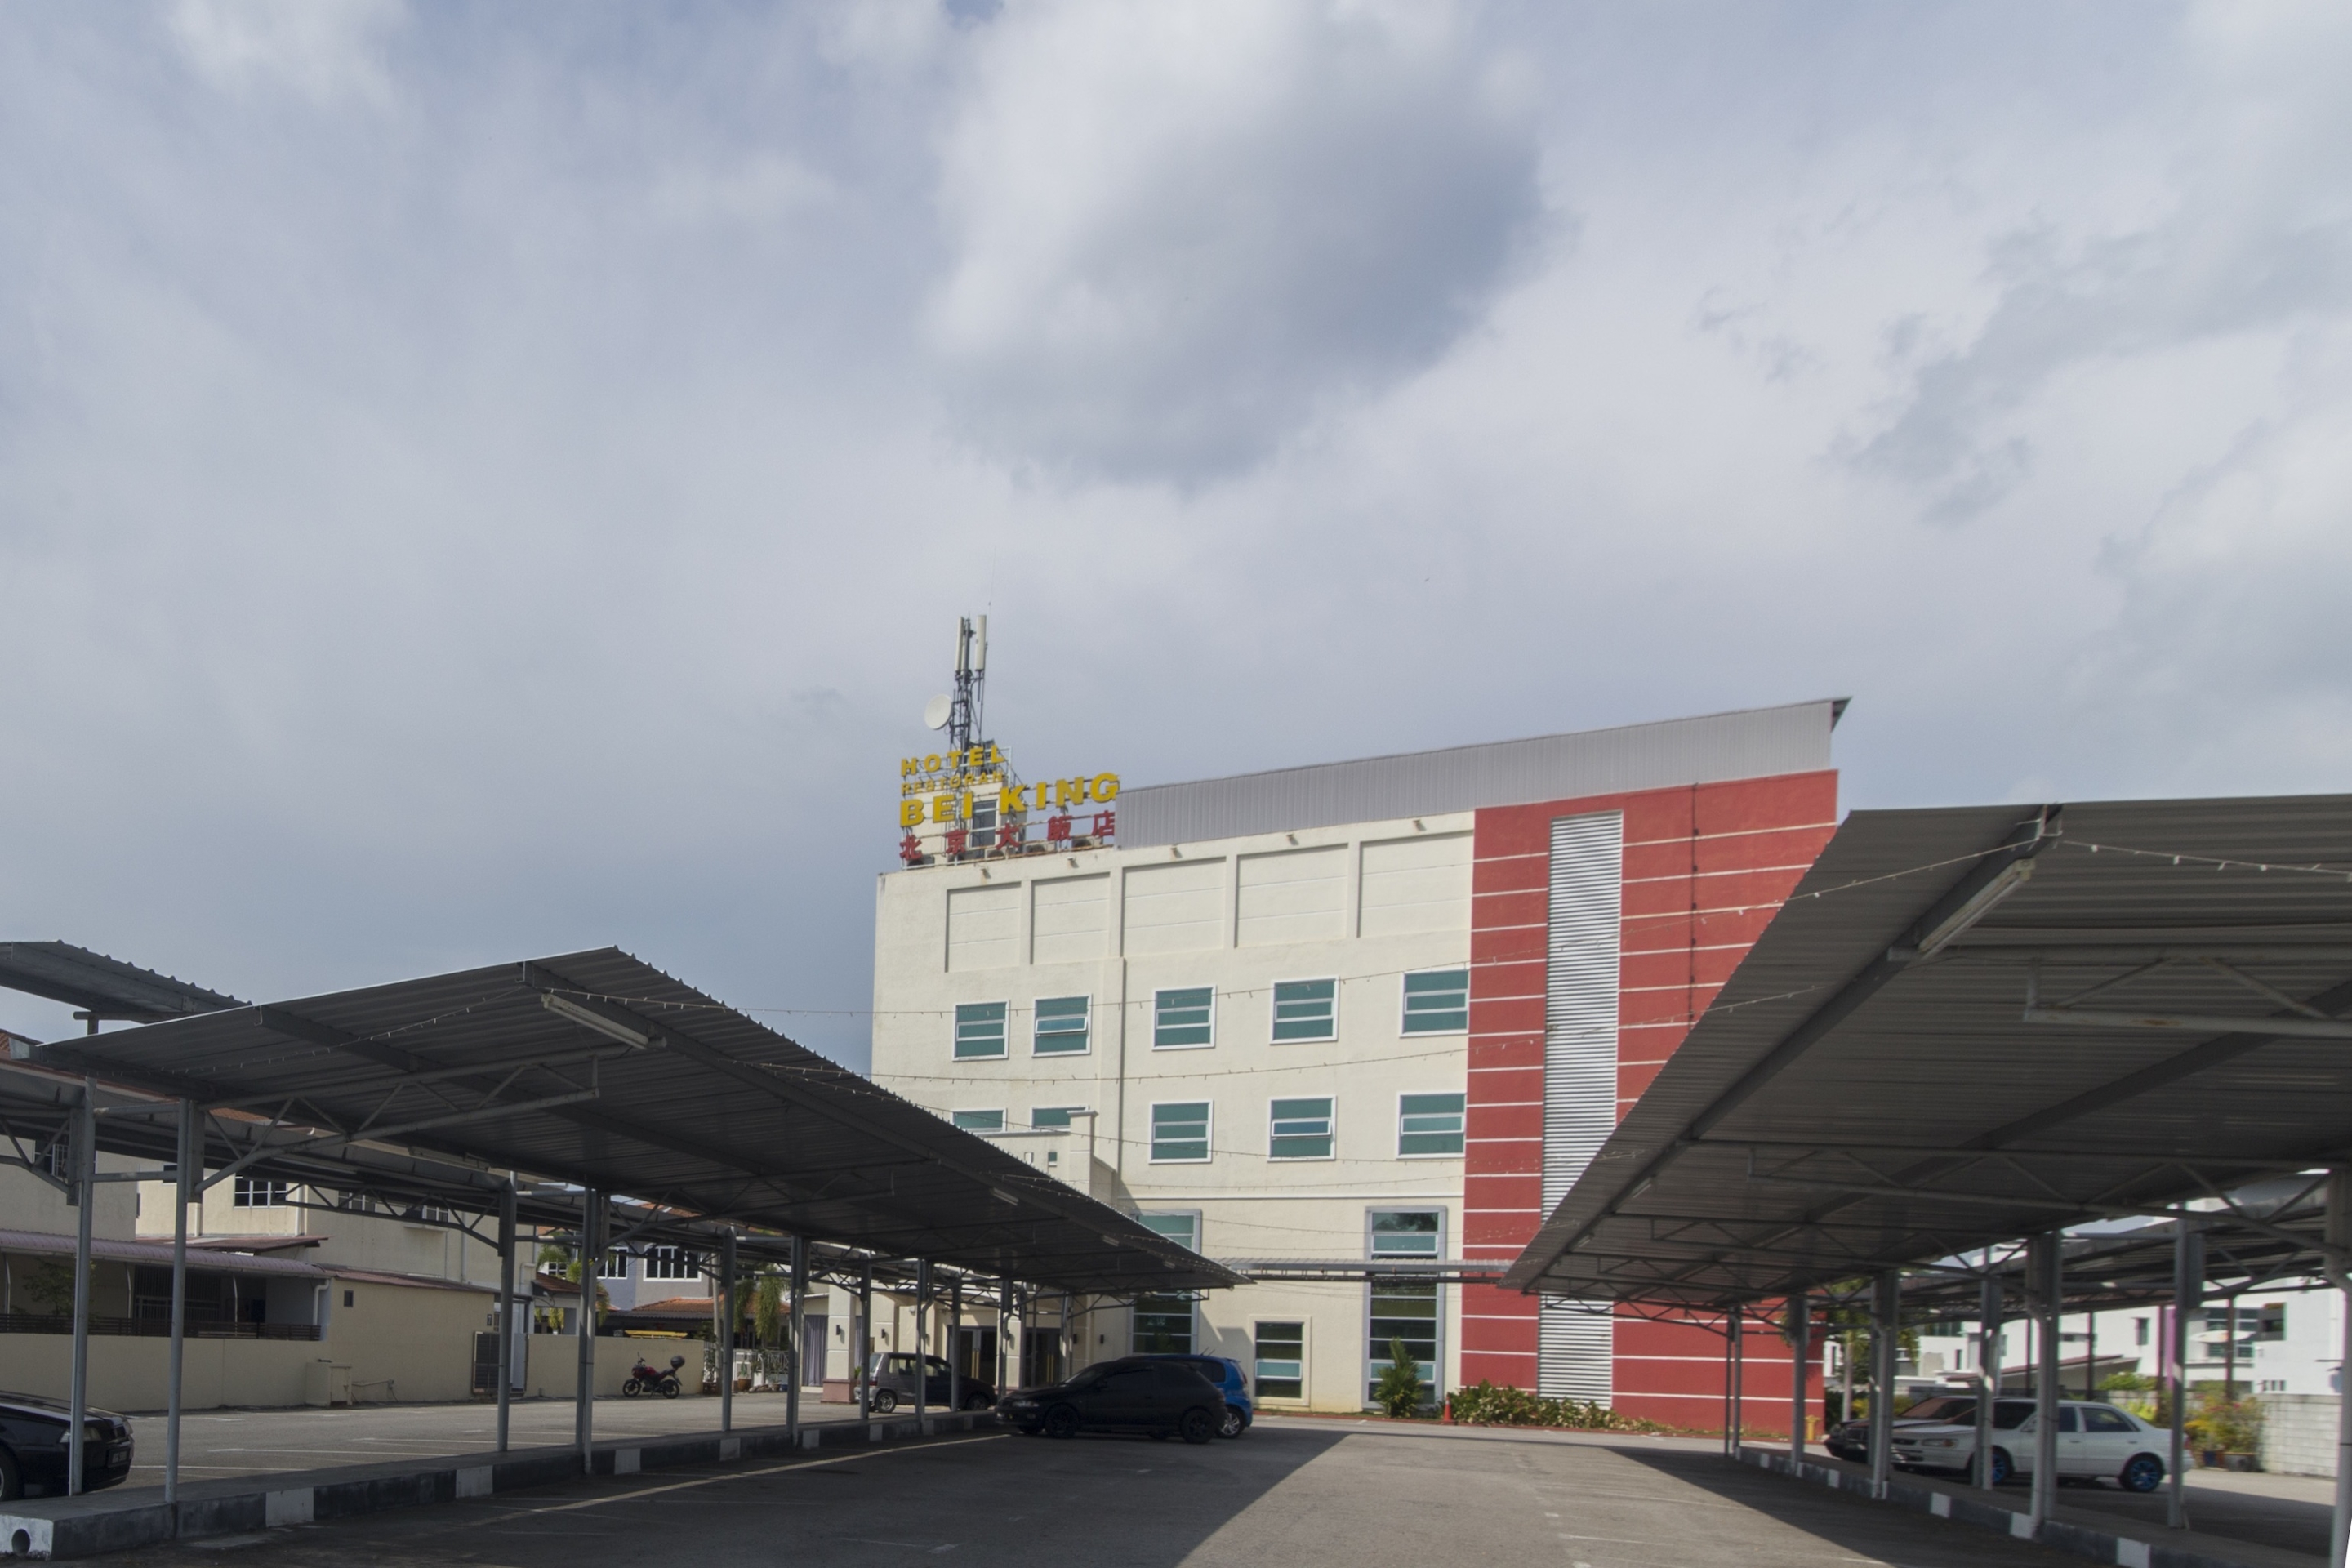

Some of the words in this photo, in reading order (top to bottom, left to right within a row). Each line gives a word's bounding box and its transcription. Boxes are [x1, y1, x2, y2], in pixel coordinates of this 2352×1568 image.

[901, 744, 1005, 777] HOTEL
[900, 792, 973, 827] BEI
[999, 772, 1120, 815] KING
[901, 771, 1004, 795] RESTORAN
[899, 810, 1116, 860] 北京大飯店
